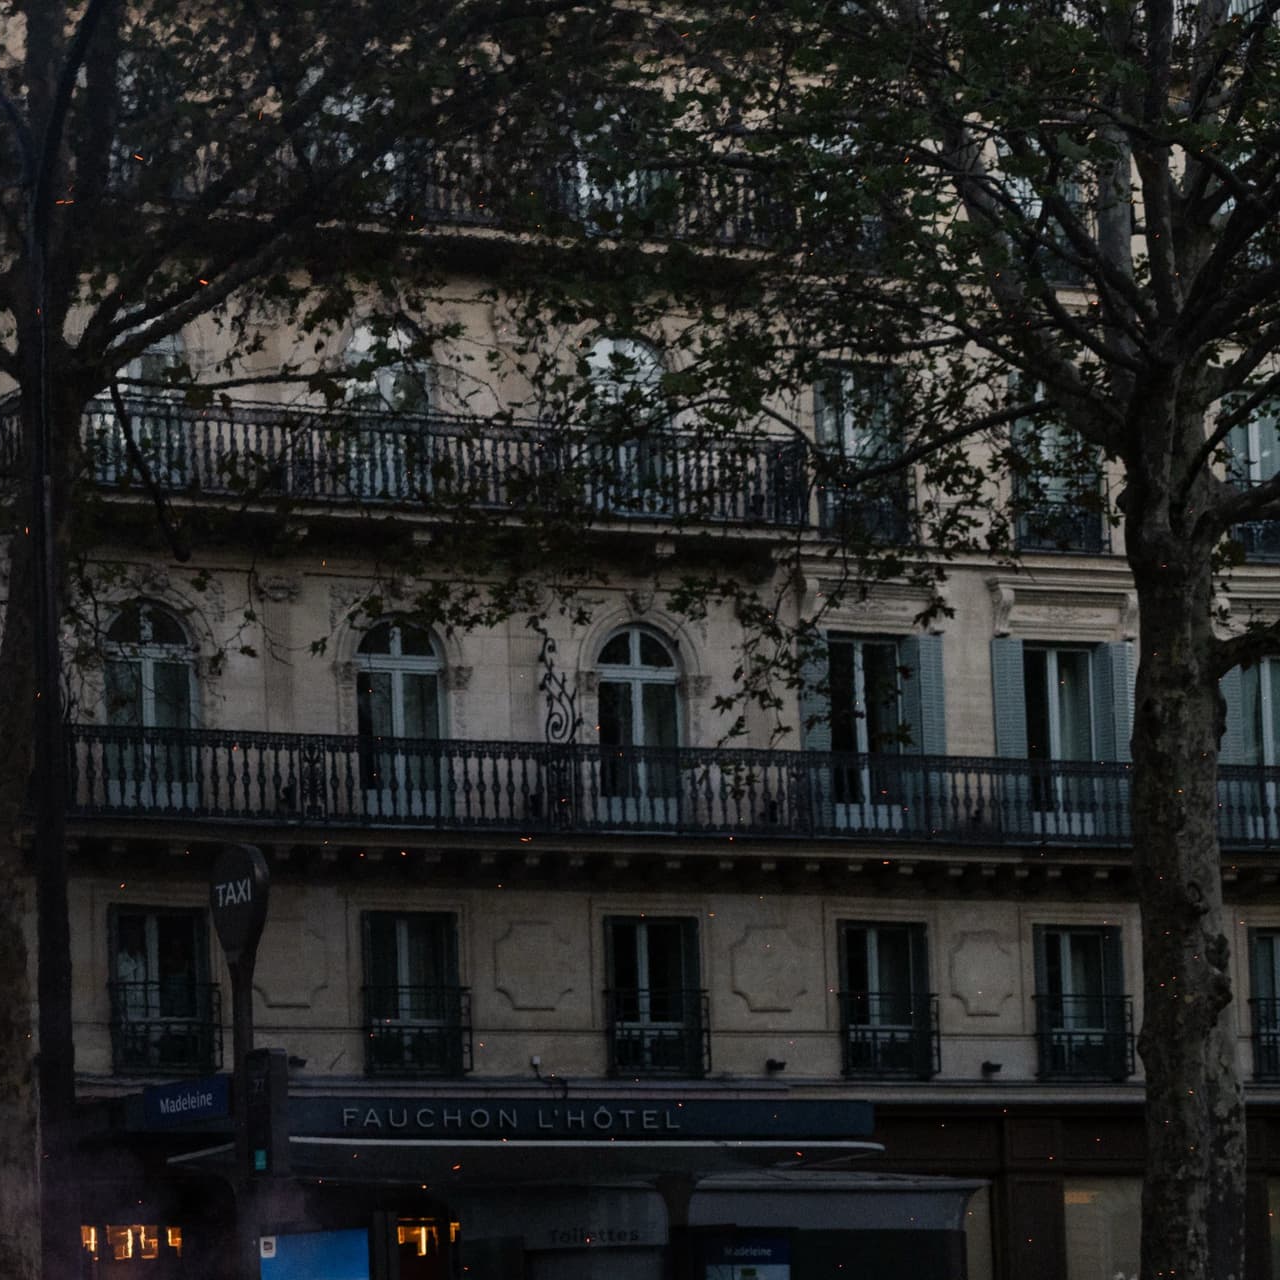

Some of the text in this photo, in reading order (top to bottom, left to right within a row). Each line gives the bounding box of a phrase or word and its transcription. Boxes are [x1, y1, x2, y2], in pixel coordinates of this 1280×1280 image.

[216, 877, 252, 908] TAXI
[160, 1090, 214, 1113] Madeleine
[343, 1105, 682, 1130] FAUCHON L'HÔTEL
